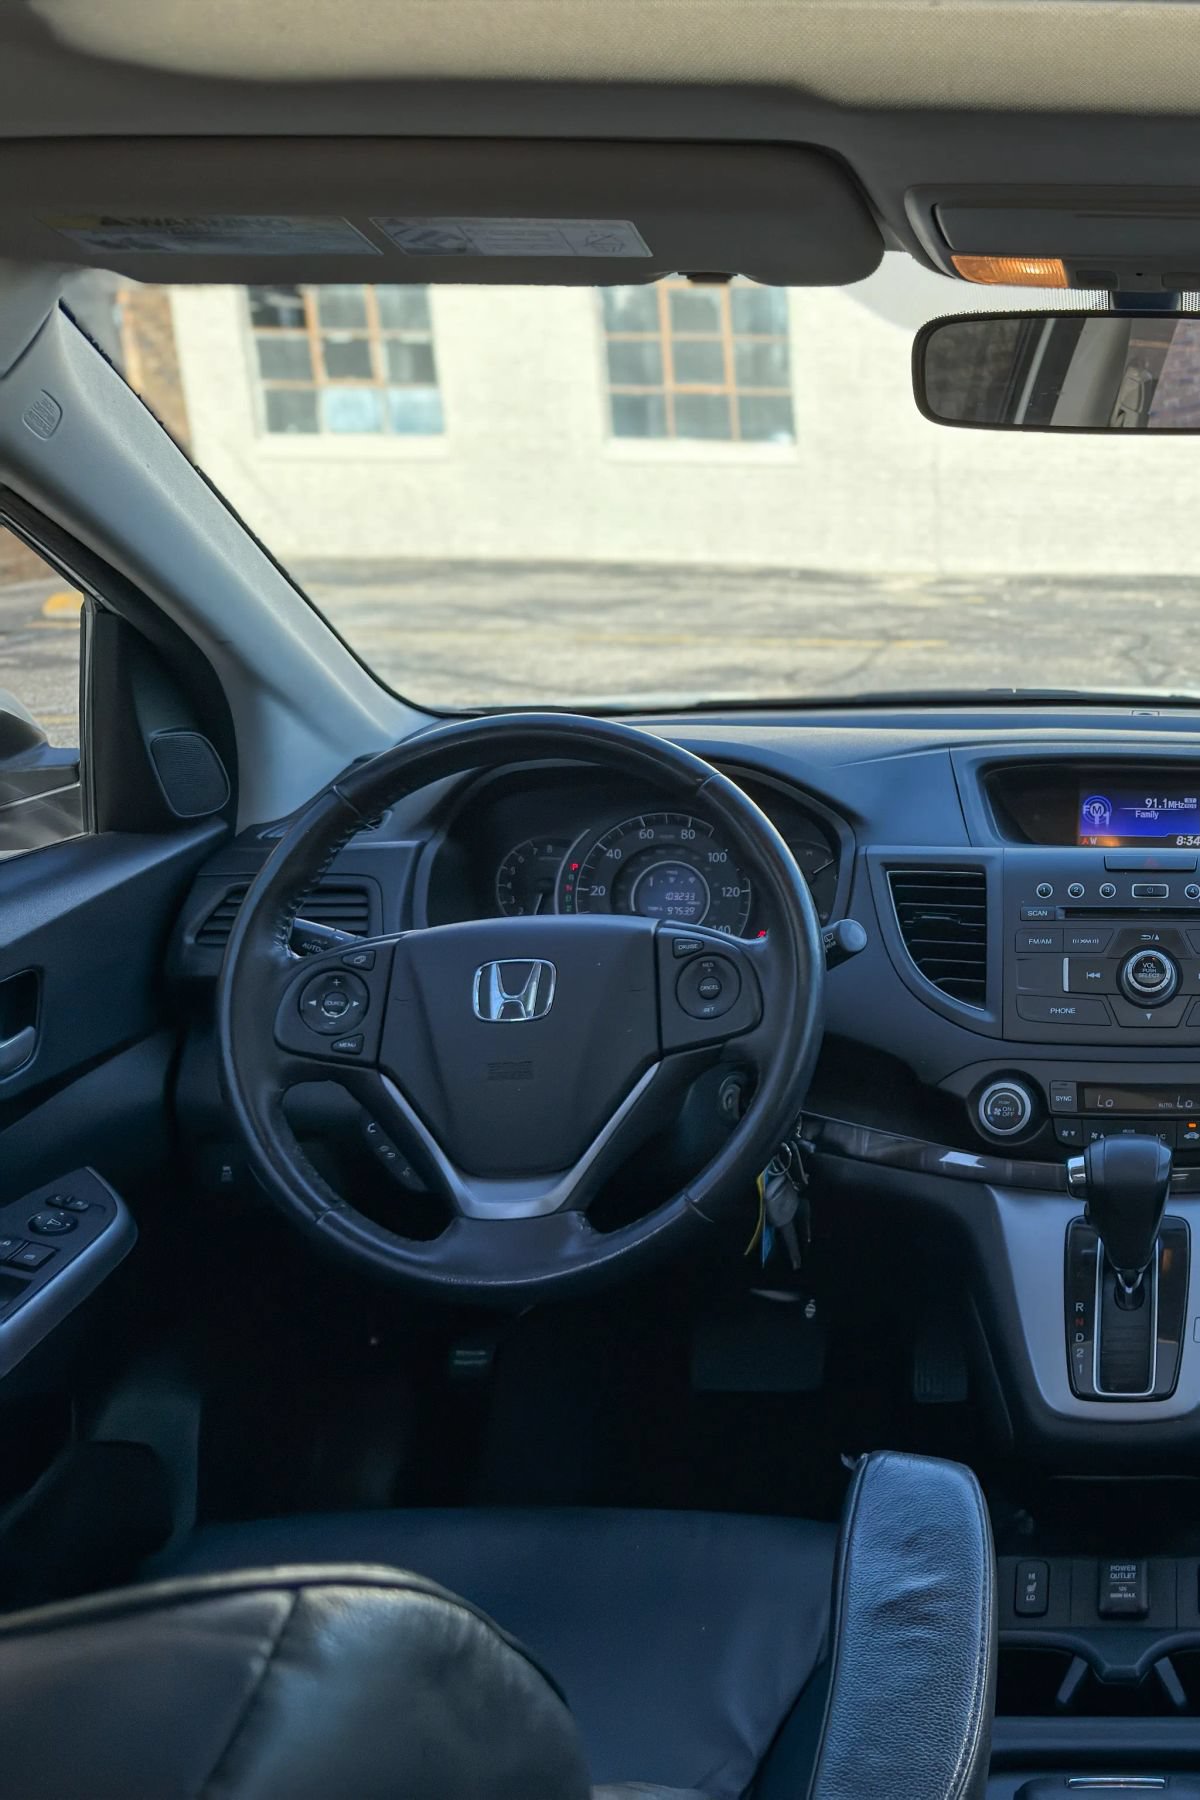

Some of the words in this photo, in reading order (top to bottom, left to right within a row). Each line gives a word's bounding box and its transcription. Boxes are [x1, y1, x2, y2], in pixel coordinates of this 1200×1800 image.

[1135, 810, 1160, 820] Family
[639, 829, 654, 840] 60
[680, 829, 696, 840] 80
[1176, 835, 1200, 846] 8:34
[606, 849, 622, 860] 40
[708, 852, 727, 863] 100
[590, 886, 606, 896] 20
[721, 887, 741, 898] 120
[302, 942, 321, 952] AUTO
[1075, 1302, 1084, 1312] R
[1075, 1317, 1084, 1326] N
[1075, 1333, 1084, 1343] D
[1076, 1348, 1084, 1357] 2
